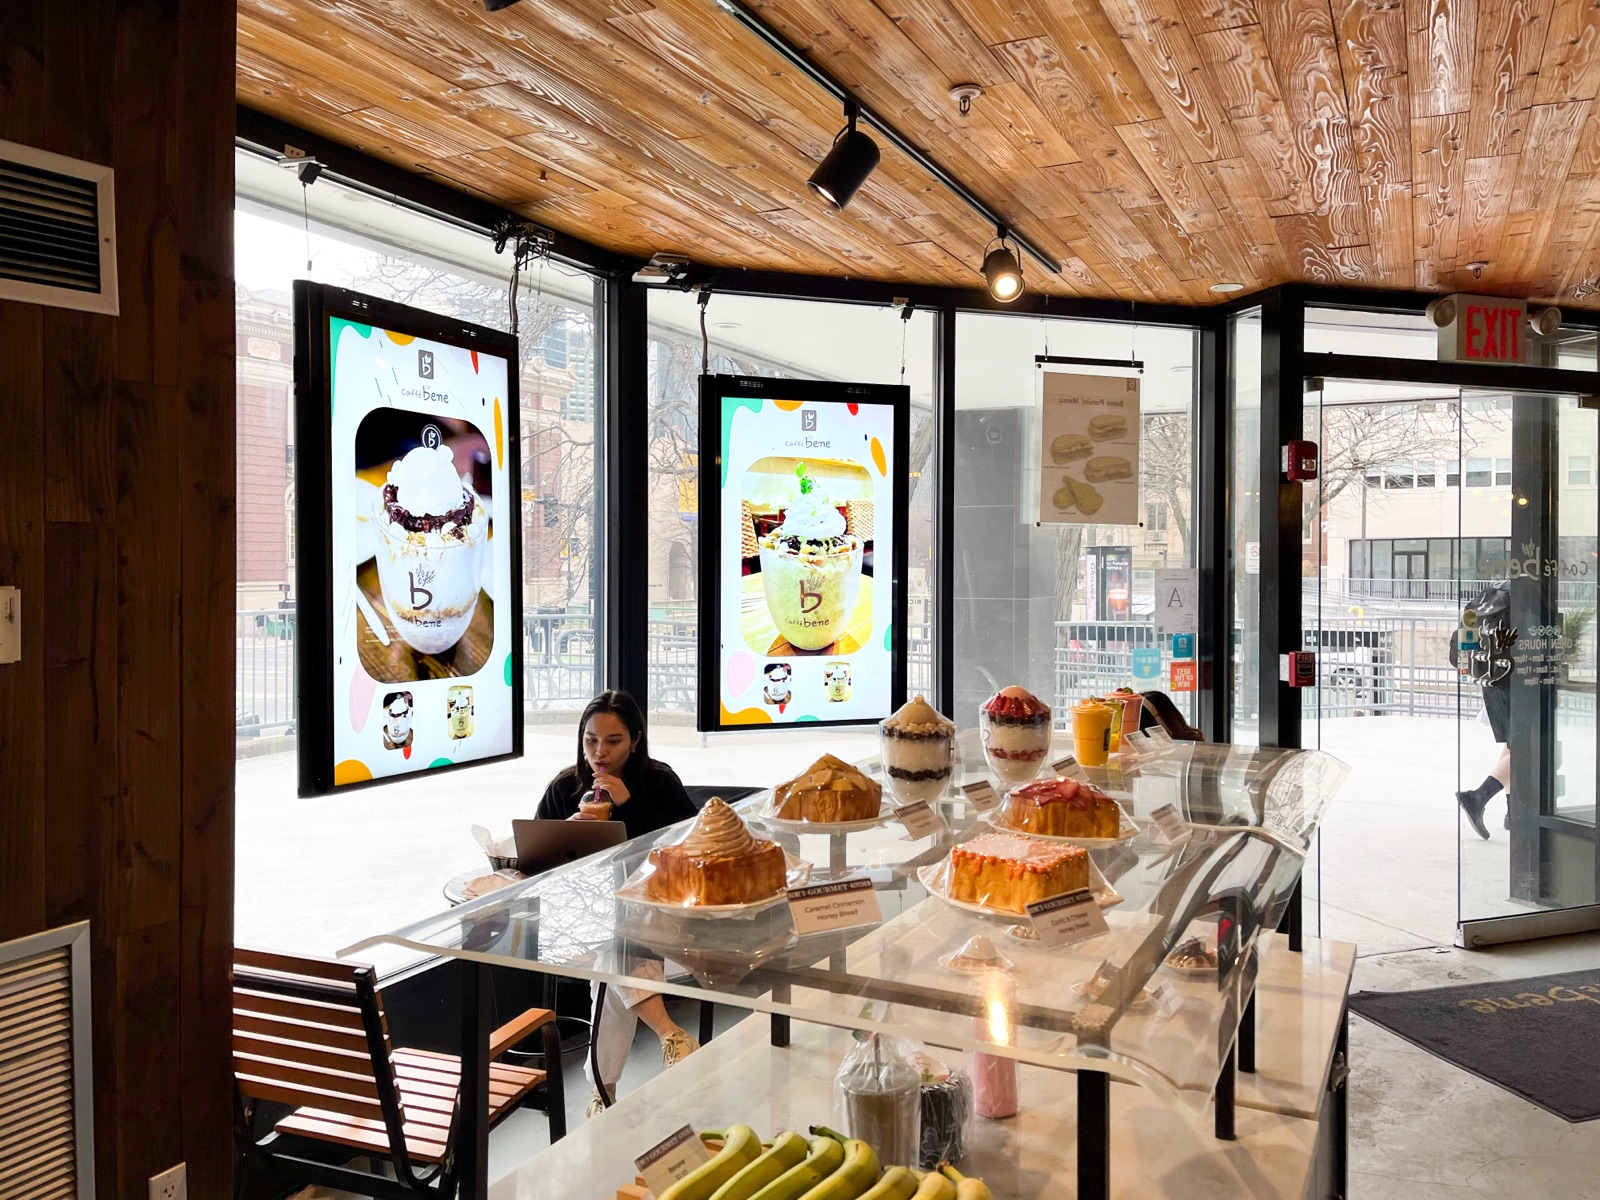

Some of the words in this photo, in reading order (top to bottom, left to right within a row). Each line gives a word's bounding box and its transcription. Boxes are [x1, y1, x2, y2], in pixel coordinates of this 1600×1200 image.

[1466, 305, 1523, 359] EXIT
[422, 385, 449, 404] bene
[805, 436, 832, 449] bene
[1167, 587, 1184, 608] A
[415, 616, 442, 628] bene
[803, 618, 830, 628] bene
[807, 884, 848, 895] GOURMET
[805, 903, 832, 914] Caramel
[832, 899, 866, 909] Cinnamon
[817, 911, 839, 921] Honey
[839, 908, 858, 918] Bread
